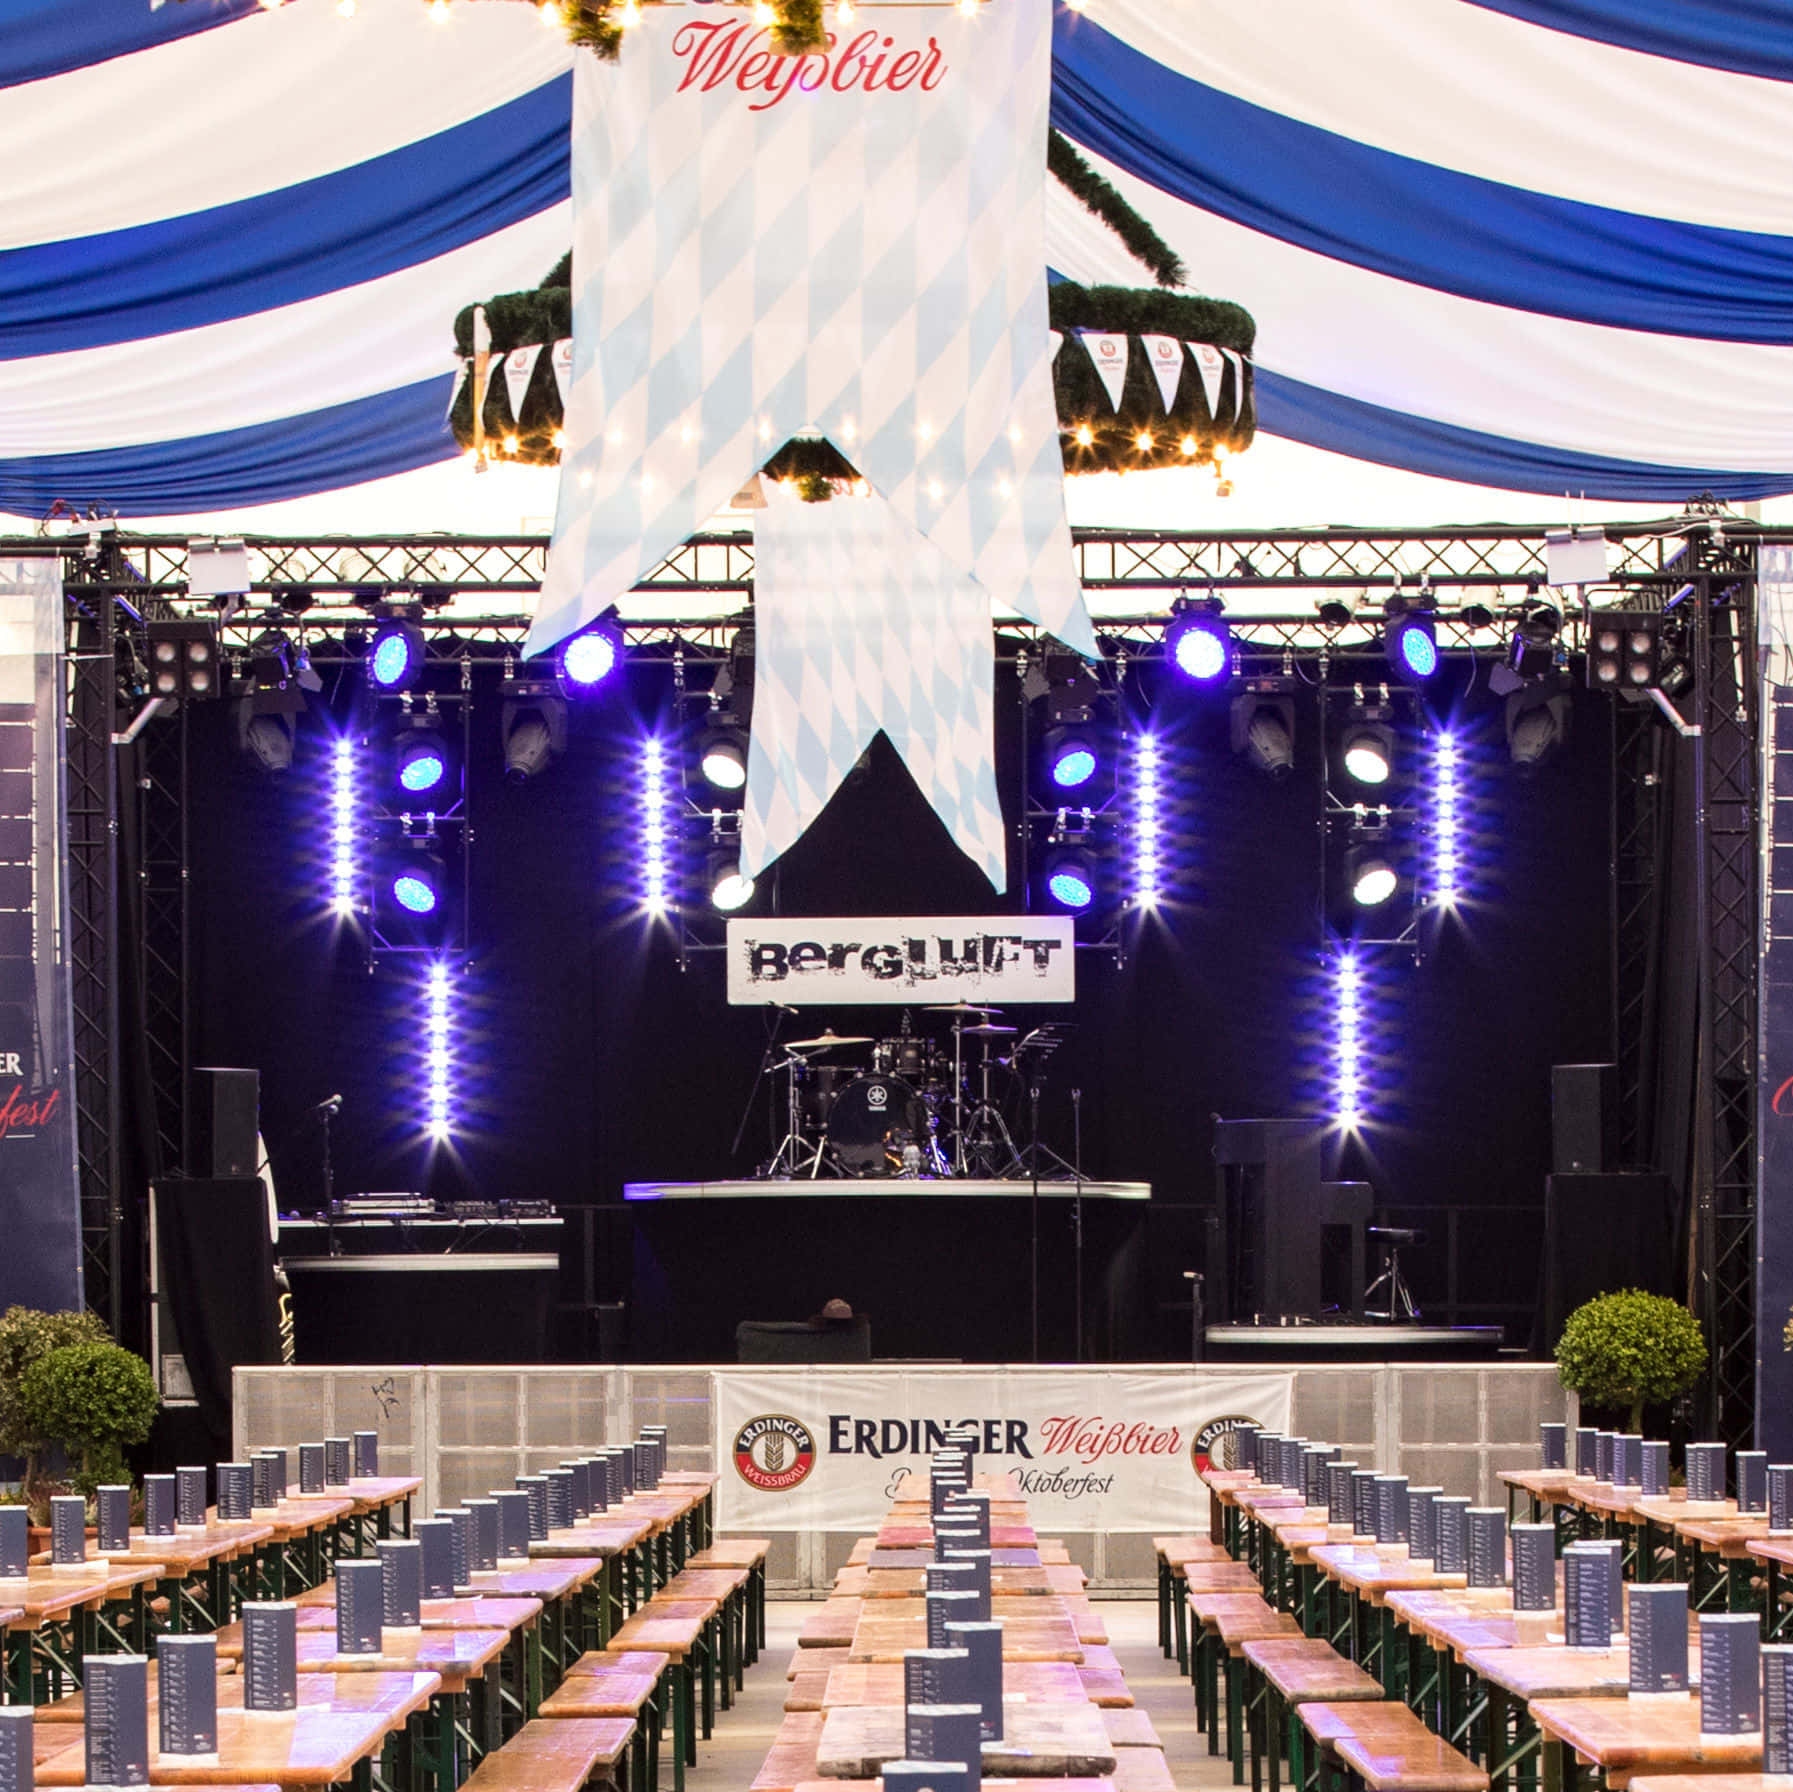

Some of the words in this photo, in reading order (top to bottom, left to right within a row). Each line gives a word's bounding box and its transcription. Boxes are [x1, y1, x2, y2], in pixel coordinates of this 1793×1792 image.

[738, 1418, 810, 1449] ERDINGER
[828, 1415, 1034, 1460] ERDINGER
[1040, 1415, 1184, 1465] Weißbier
